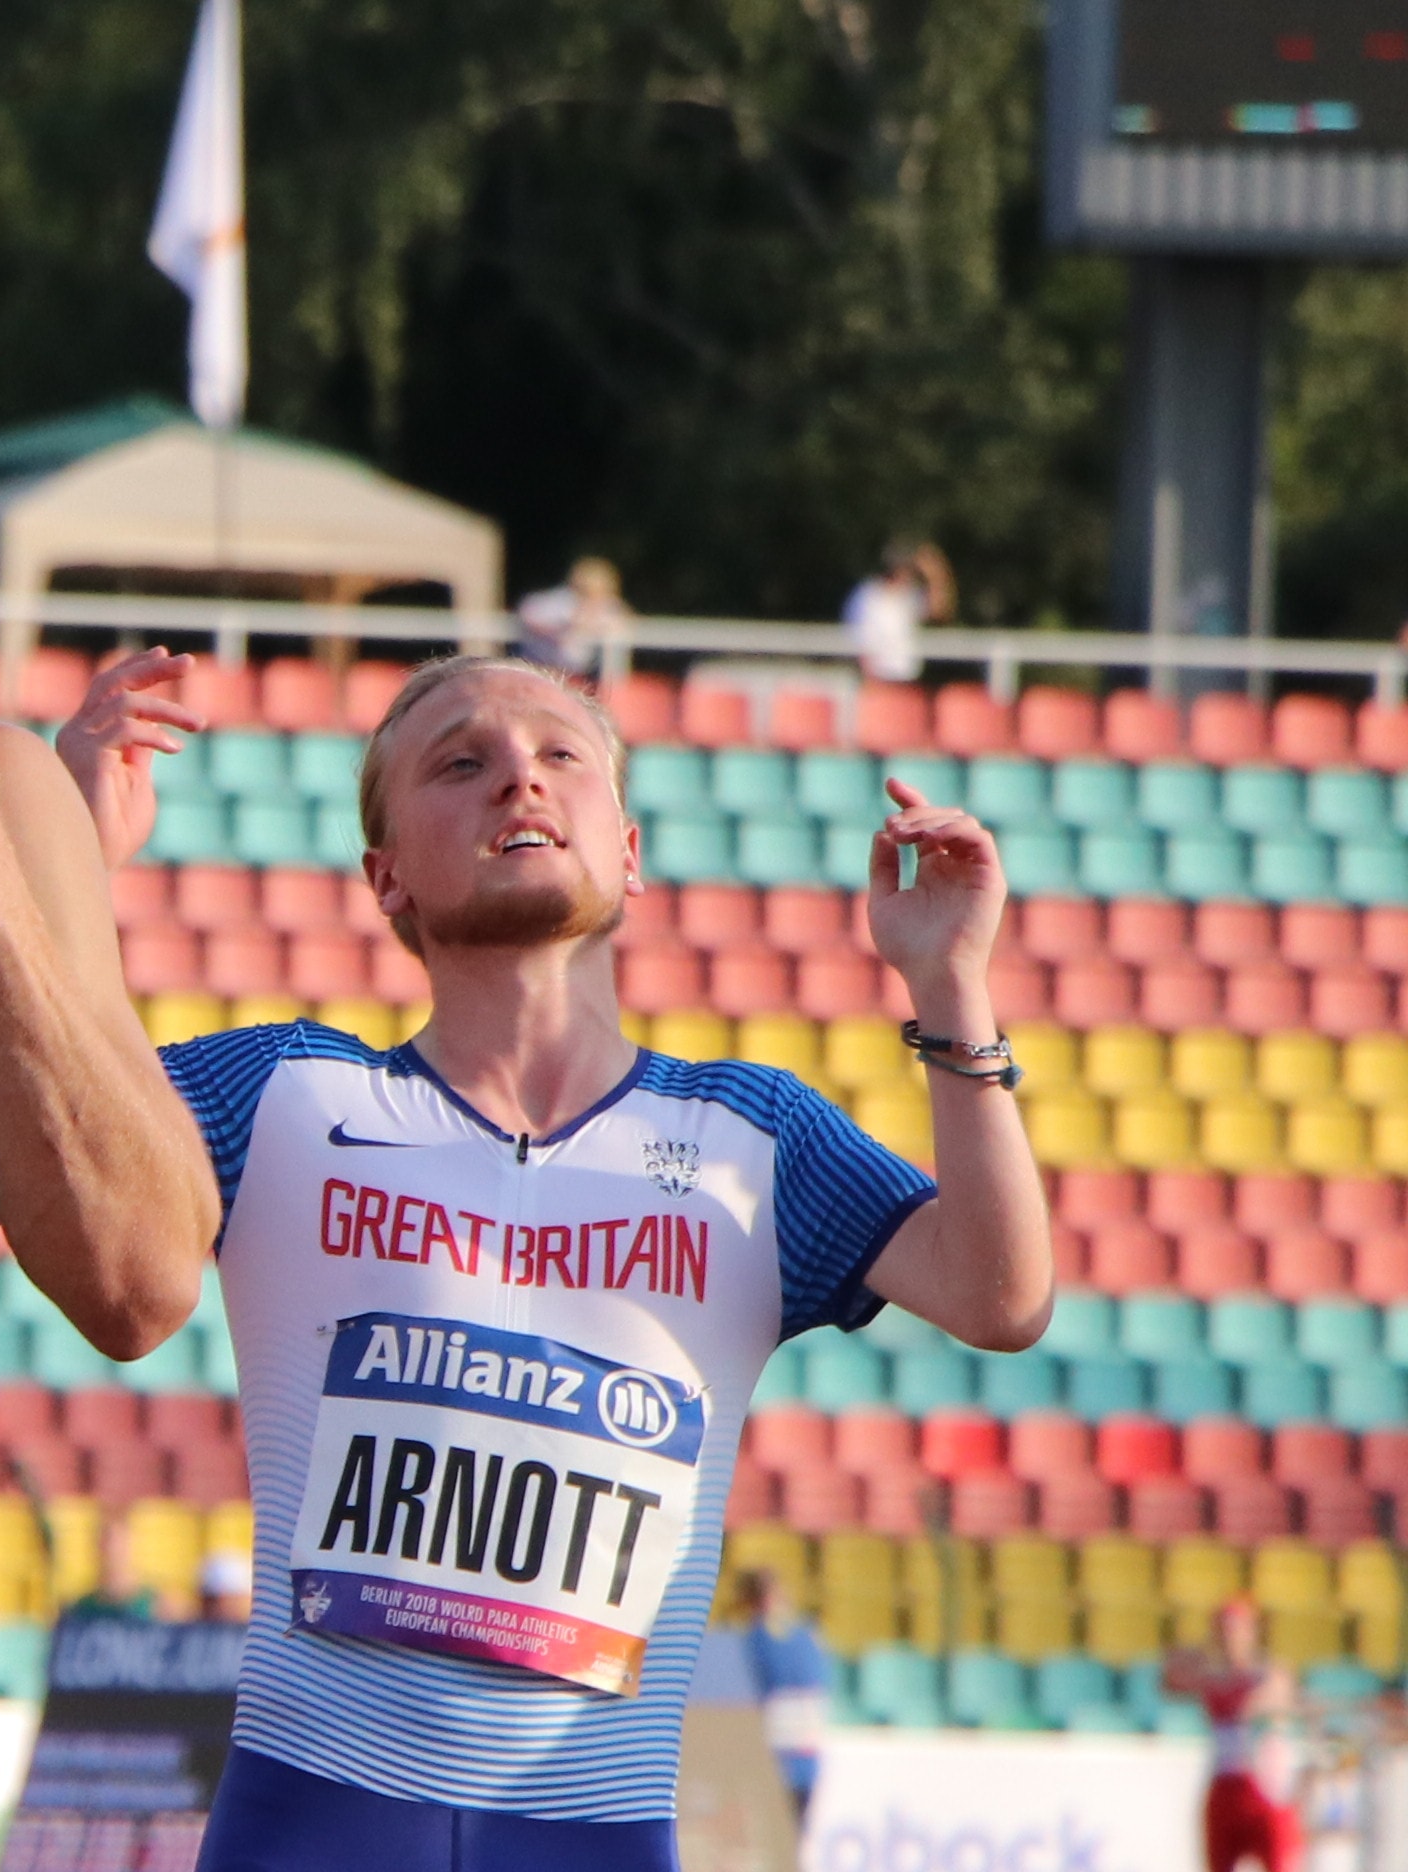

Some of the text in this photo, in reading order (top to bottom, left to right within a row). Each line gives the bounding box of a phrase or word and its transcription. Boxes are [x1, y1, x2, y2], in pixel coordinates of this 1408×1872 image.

[320, 1177, 709, 1304] GREAT BRITAIN
[353, 1324, 586, 1416] Allianz
[318, 1434, 661, 1608] ARNOTT
[360, 1584, 579, 1645] BERLIN 2018 WOLRD PARA ATHLETICS
[385, 1608, 550, 1657] EUROPEAN CHAMPIONSHIPS
